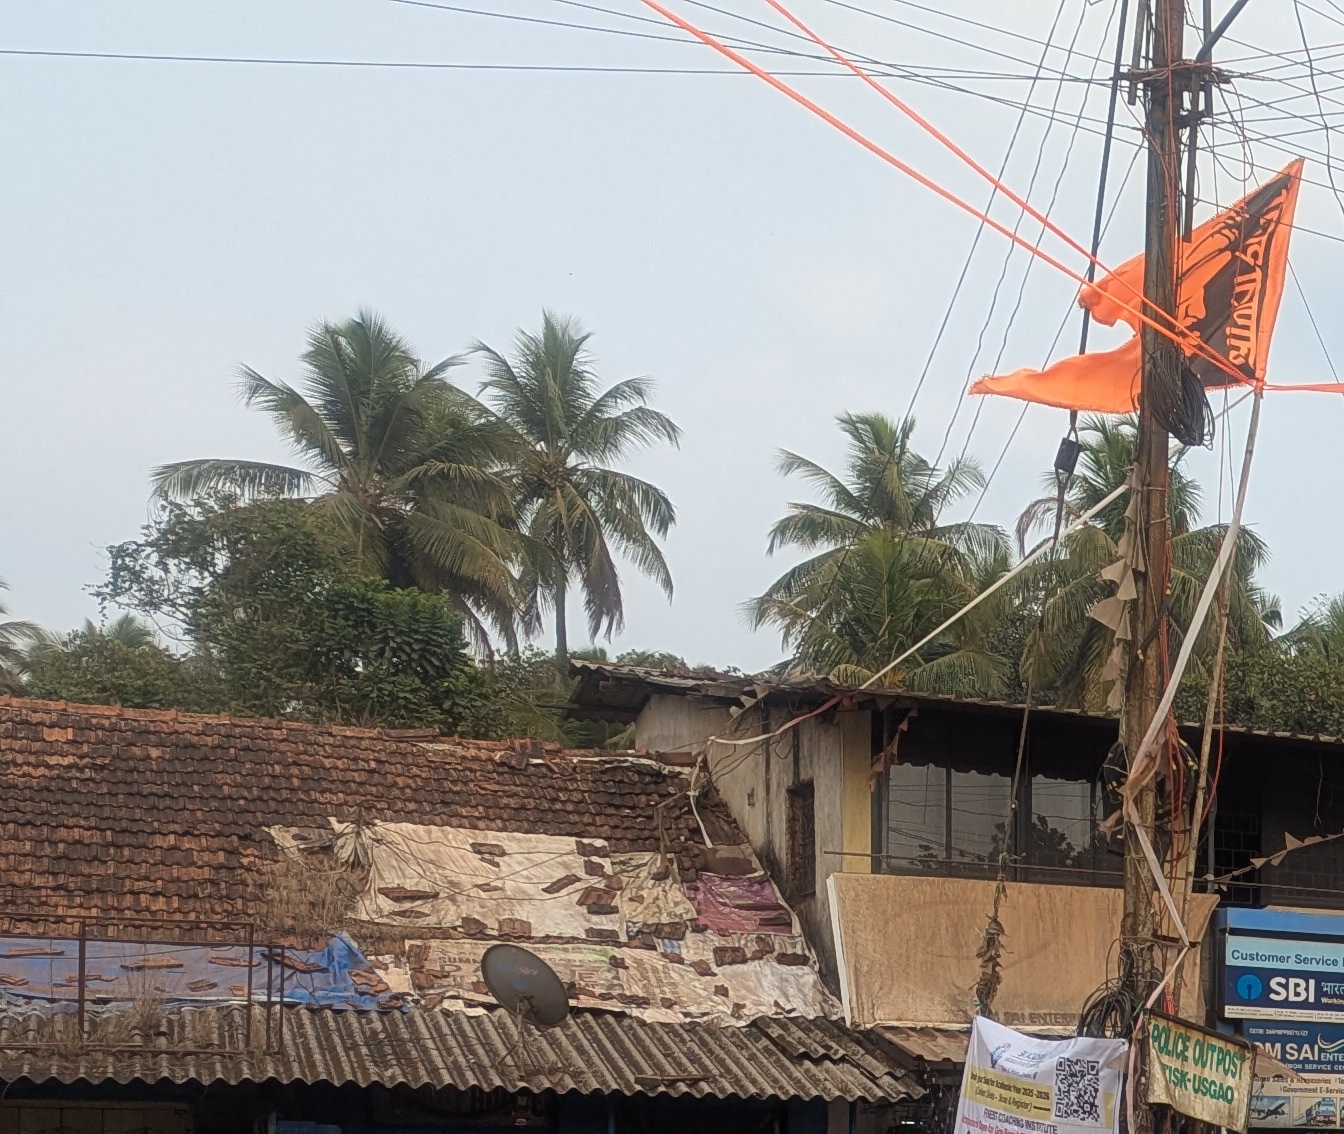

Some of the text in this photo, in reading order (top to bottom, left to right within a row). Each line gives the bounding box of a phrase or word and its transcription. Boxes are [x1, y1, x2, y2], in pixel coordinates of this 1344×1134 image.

[1231, 949, 1292, 966] Customer
[1294, 953, 1339, 968] Service
[1269, 976, 1316, 1003] SBI
[1152, 1022, 1246, 1080] POLICE OUTPOST
[1285, 1043, 1318, 1061] SAI
[1162, 1062, 1235, 1105] TISK-USGAO
